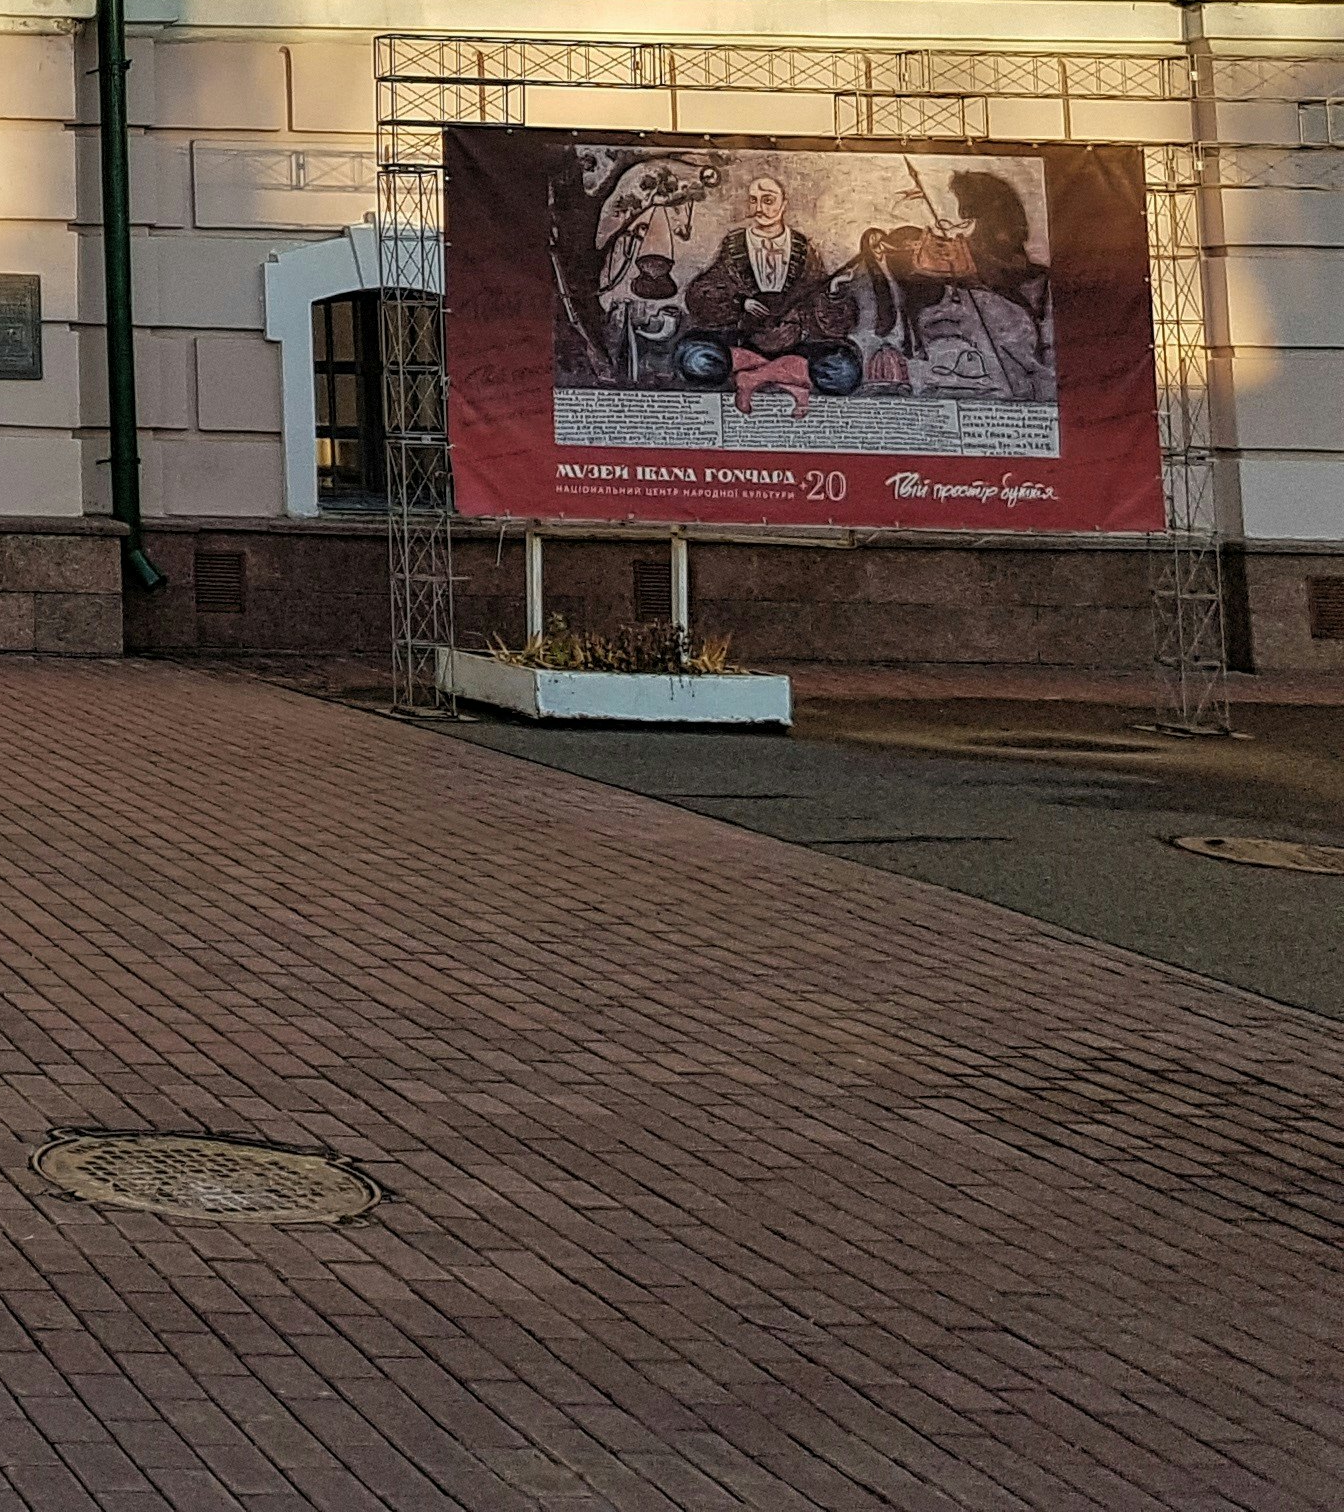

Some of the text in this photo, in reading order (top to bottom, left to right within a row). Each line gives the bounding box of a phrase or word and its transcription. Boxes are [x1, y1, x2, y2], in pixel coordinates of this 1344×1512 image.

[555, 463, 796, 484] МУЗЕЙ ІВАНА ГОНЧАРА
[555, 485, 795, 500] НАЦІОНАЛЬНИЙ ЦЕНТР НАРОДНОЇ КУЛЬТУРИ
[884, 471, 932, 500] Твій
